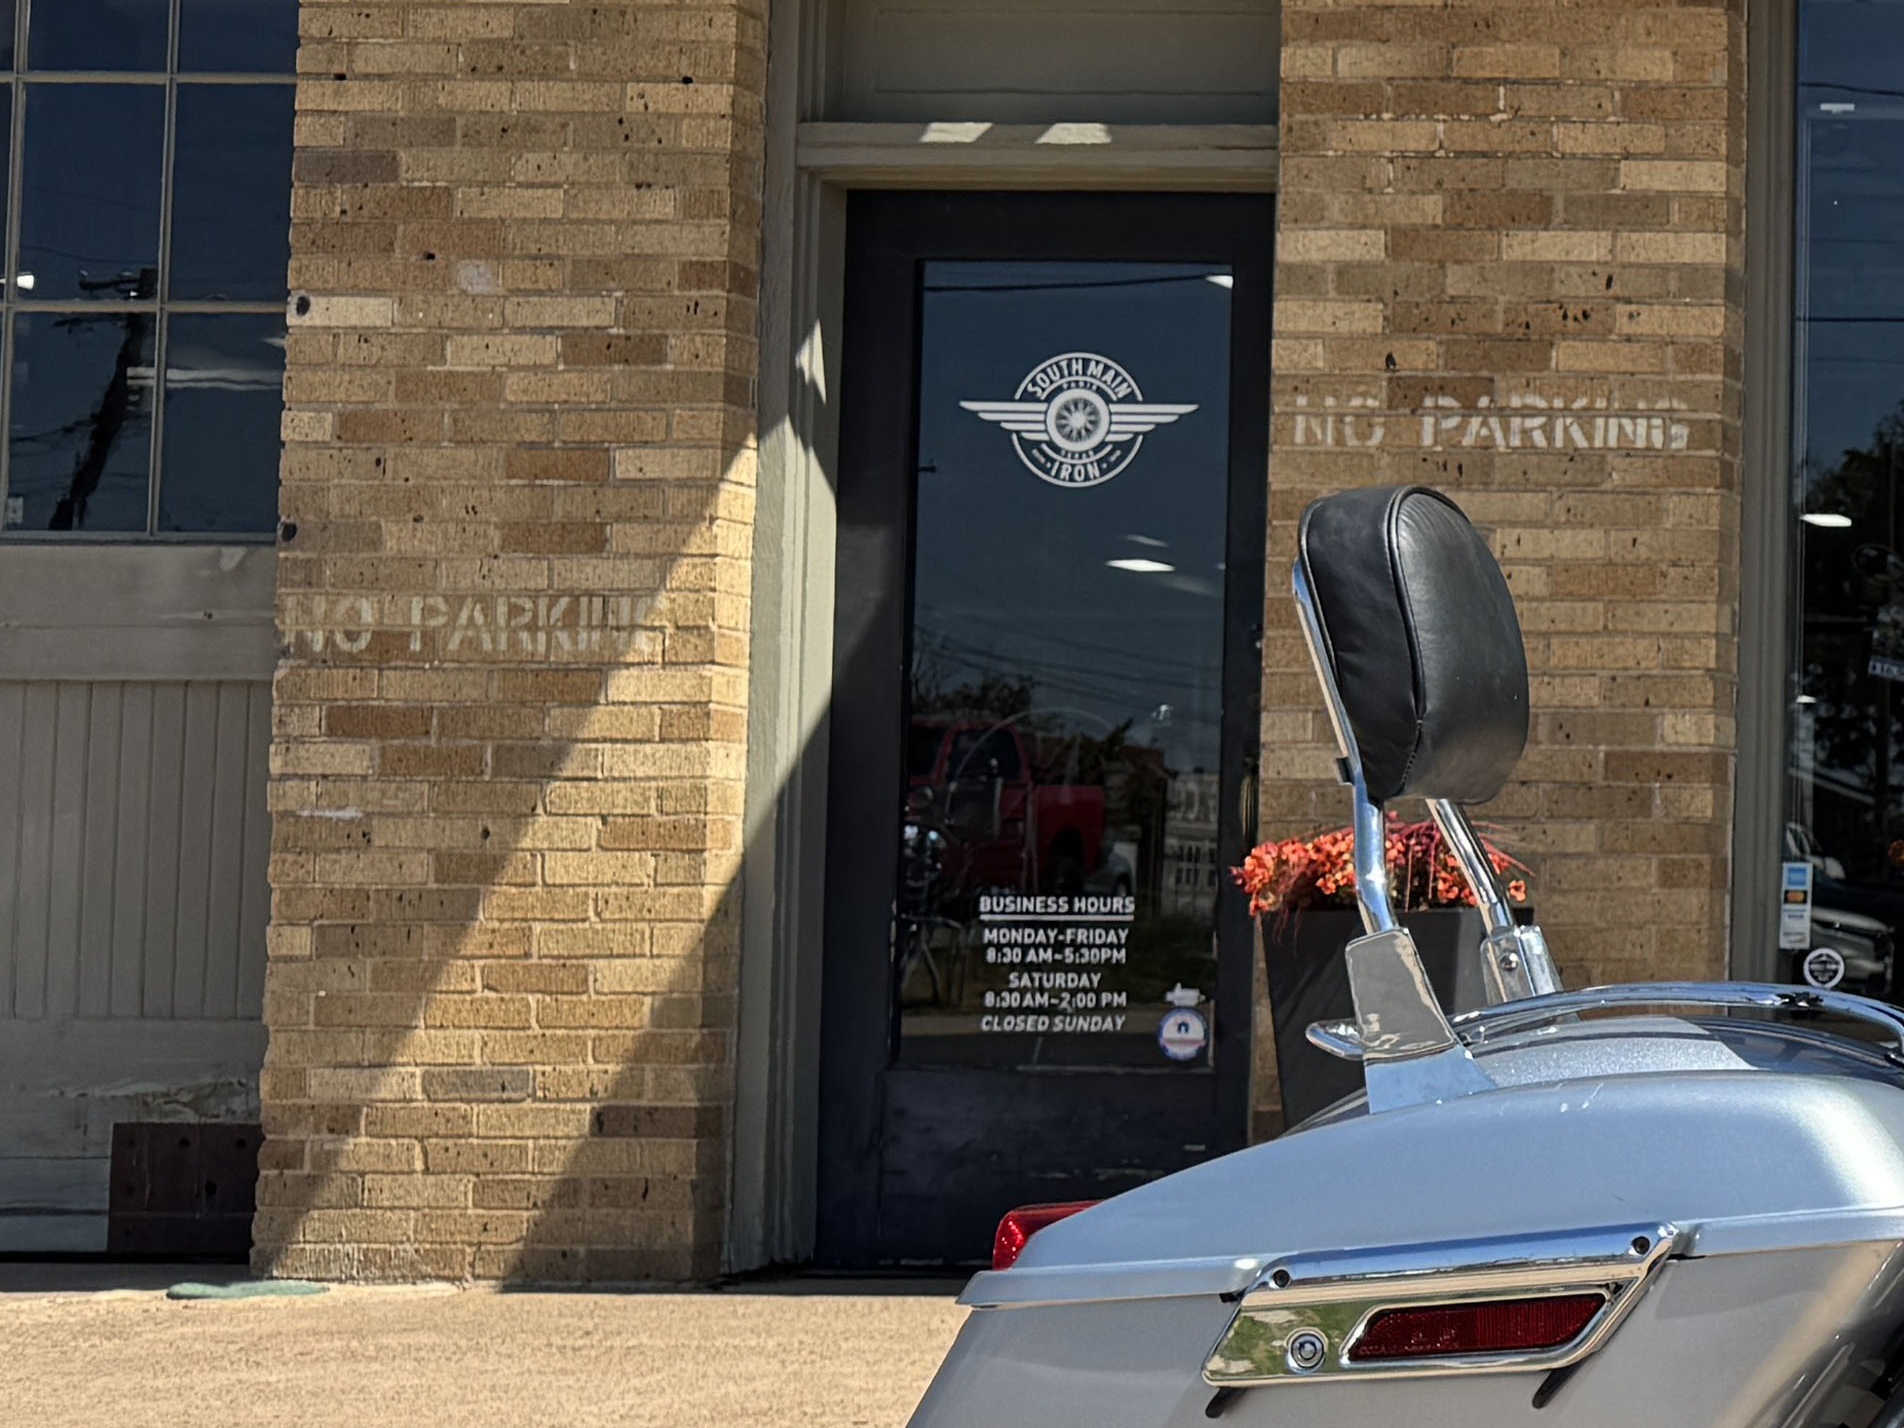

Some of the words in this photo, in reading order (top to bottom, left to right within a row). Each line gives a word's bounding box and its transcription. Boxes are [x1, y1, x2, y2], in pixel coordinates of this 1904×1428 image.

[1027, 358, 1083, 398] SOUTH
[1087, 359, 1133, 399] MAIN
[1295, 395, 1386, 448] NO
[1421, 393, 1690, 449] PARKING
[1051, 460, 1101, 482] IRON
[979, 896, 1069, 913] BUSINESS
[1074, 896, 1135, 913] HOURS
[983, 928, 1129, 945] MONDAY-FRIDAY
[1009, 972, 1102, 989] SATURDAY
[1101, 991, 1127, 1008] PM
[981, 1015, 1050, 1032] CLOSED
[1052, 1015, 1126, 1032] SUNDAY
